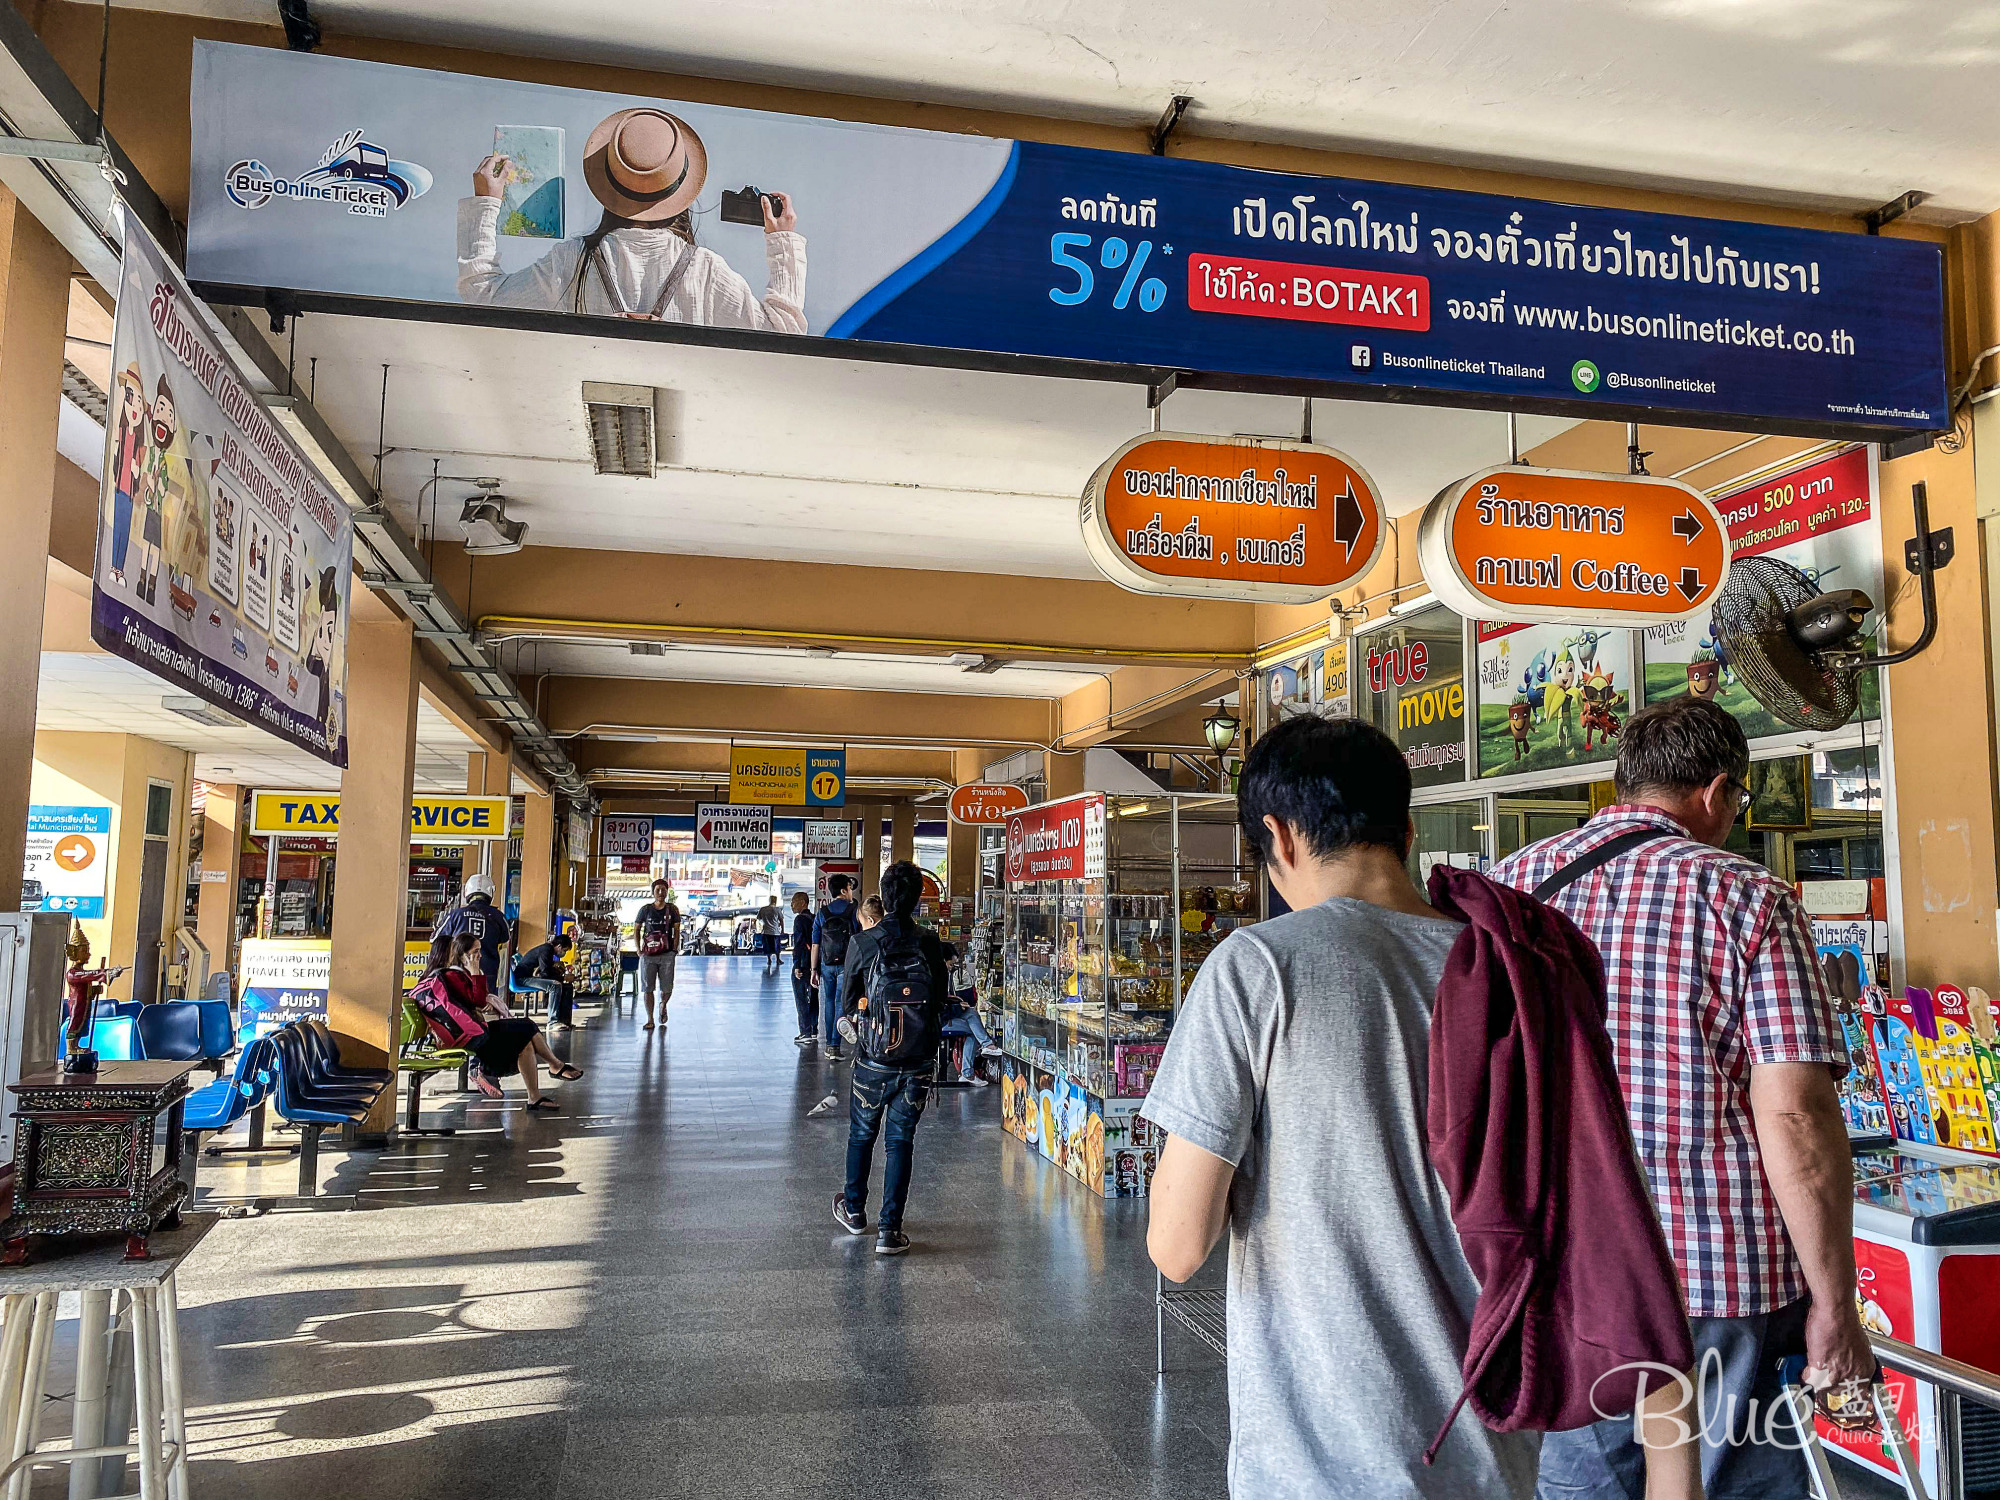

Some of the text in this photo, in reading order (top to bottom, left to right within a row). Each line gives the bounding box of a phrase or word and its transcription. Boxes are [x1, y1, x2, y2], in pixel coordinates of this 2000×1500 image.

[236, 174, 388, 206] BusOnlineTicket
[1061, 192, 1158, 228] ลดทันที
[1232, 195, 1821, 295] เปิดโลกใหม่ จองตั๋วเที่ยวไทยไปกับเรา!
[1446, 289, 1856, 356] จองที่ www.busonlineticket.co.th
[1382, 351, 1546, 380] Busonlineticket Thailand
[1605, 371, 1717, 394] @Busonlineticket
[1123, 466, 1318, 510] ของฝากจากเชียงใหม่
[1763, 483, 1795, 513] 500
[1799, 475, 1834, 500] บาท
[1476, 482, 1625, 536] ร้านอาหาร
[1806, 503, 1837, 531] มูลค่า
[1840, 497, 1870, 517] 120.-
[1124, 513, 1213, 561] เครื่องดื่ม
[1235, 526, 1305, 567] เบเกอรี่
[1475, 552, 1669, 596] กาแฟ Coffee
[197, 657, 235, 699] โทรสายด่วน
[1366, 641, 1429, 694] true
[1399, 684, 1464, 730] move
[736, 761, 802, 777] นครชัยแอร์
[811, 757, 840, 768] ชานชาลา
[738, 780, 786, 788] NAKHONCHAI
[815, 777, 835, 796] 17
[970, 786, 1007, 796] ร้านหนังสือ
[701, 806, 769, 818] อาหารจานด่วน
[38, 823, 83, 832] Municipality
[84, 824, 98, 832] Bus
[606, 820, 636, 839] สุขา
[713, 818, 769, 833] กาแฟสด
[807, 825, 817, 836] LEFT
[818, 825, 836, 837] LUGGAGE
[1061, 817, 1081, 849] แดง
[608, 840, 638, 853] TOILET
[713, 836, 768, 850] Fresh Coffee
[26, 852, 52, 861] ออก 2
[29, 863, 36, 872] 2
[247, 967, 287, 978] TRAVEL
[1942, 1007, 1966, 1015] วอลล์
